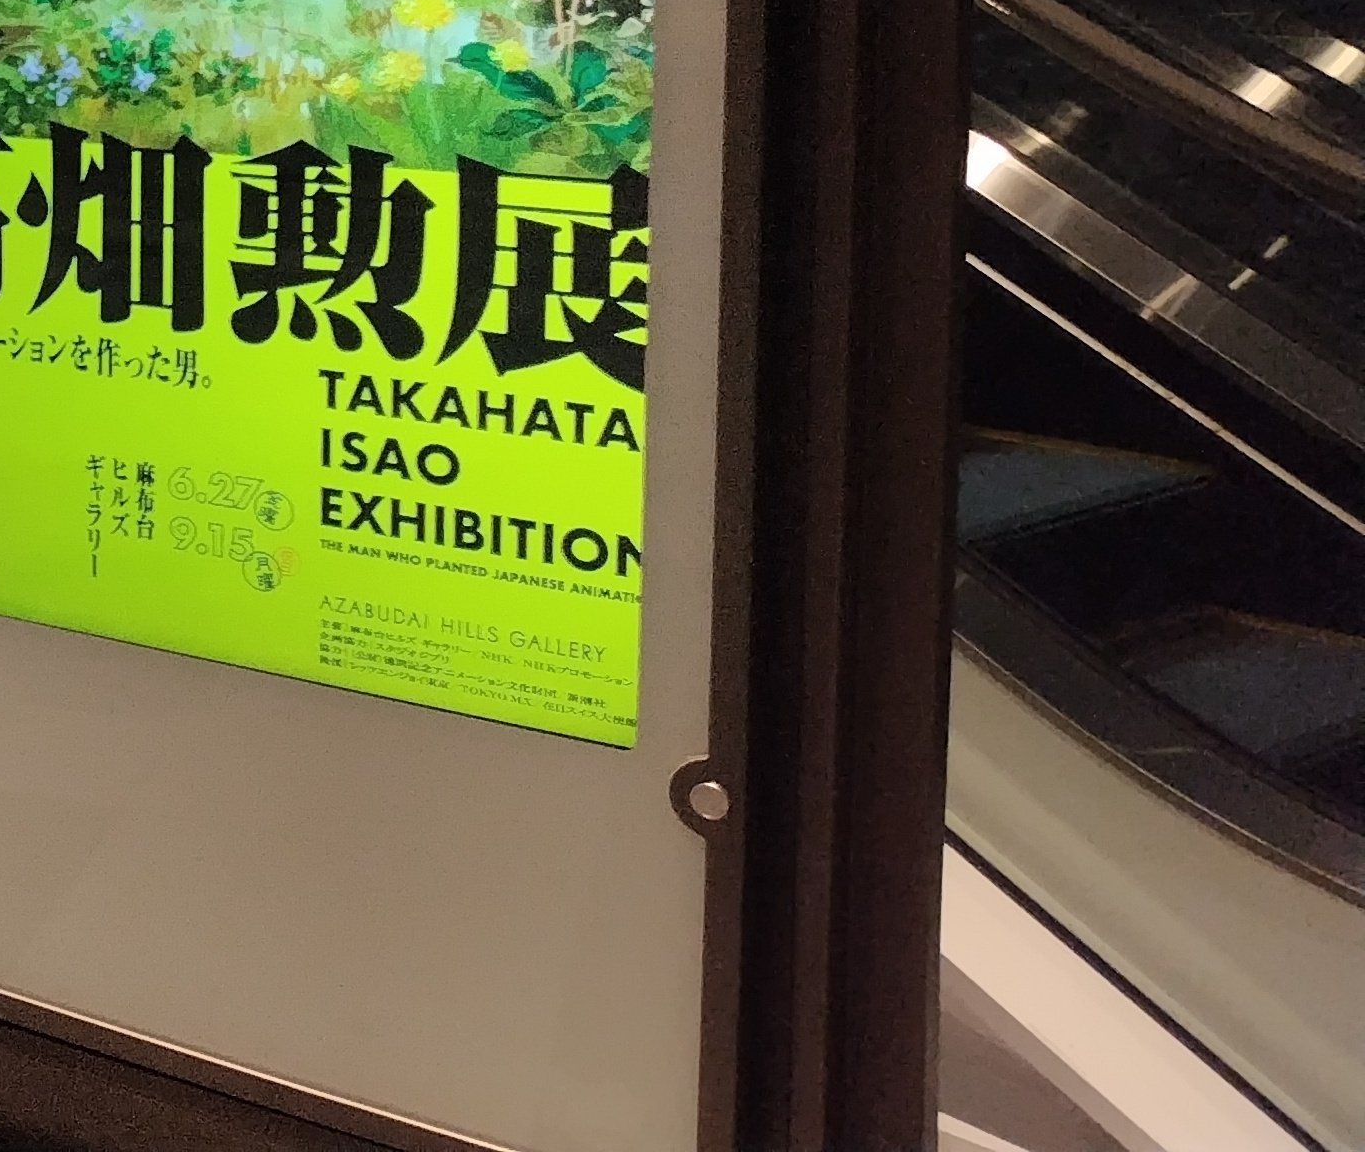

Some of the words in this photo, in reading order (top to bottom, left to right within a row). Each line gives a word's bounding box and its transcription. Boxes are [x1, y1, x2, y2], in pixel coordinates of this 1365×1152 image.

[318, 368, 641, 452] TAKAHATA
[168, 466, 265, 510] 6.27
[321, 428, 461, 486] ISAO
[85, 454, 106, 578] ギャラリー
[110, 458, 131, 538] ヒルズ
[135, 462, 156, 541] 麻布台
[169, 516, 255, 562] 9.15
[319, 538, 344, 553] THE
[347, 543, 381, 559] MAN
[385, 549, 421, 566] WHO
[426, 557, 488, 579] PLANTED
[492, 568, 565, 592] JAPANESE
[319, 595, 429, 630] AZABUDAI
[440, 617, 499, 643] HILLS
[509, 630, 606, 663] GALLERY
